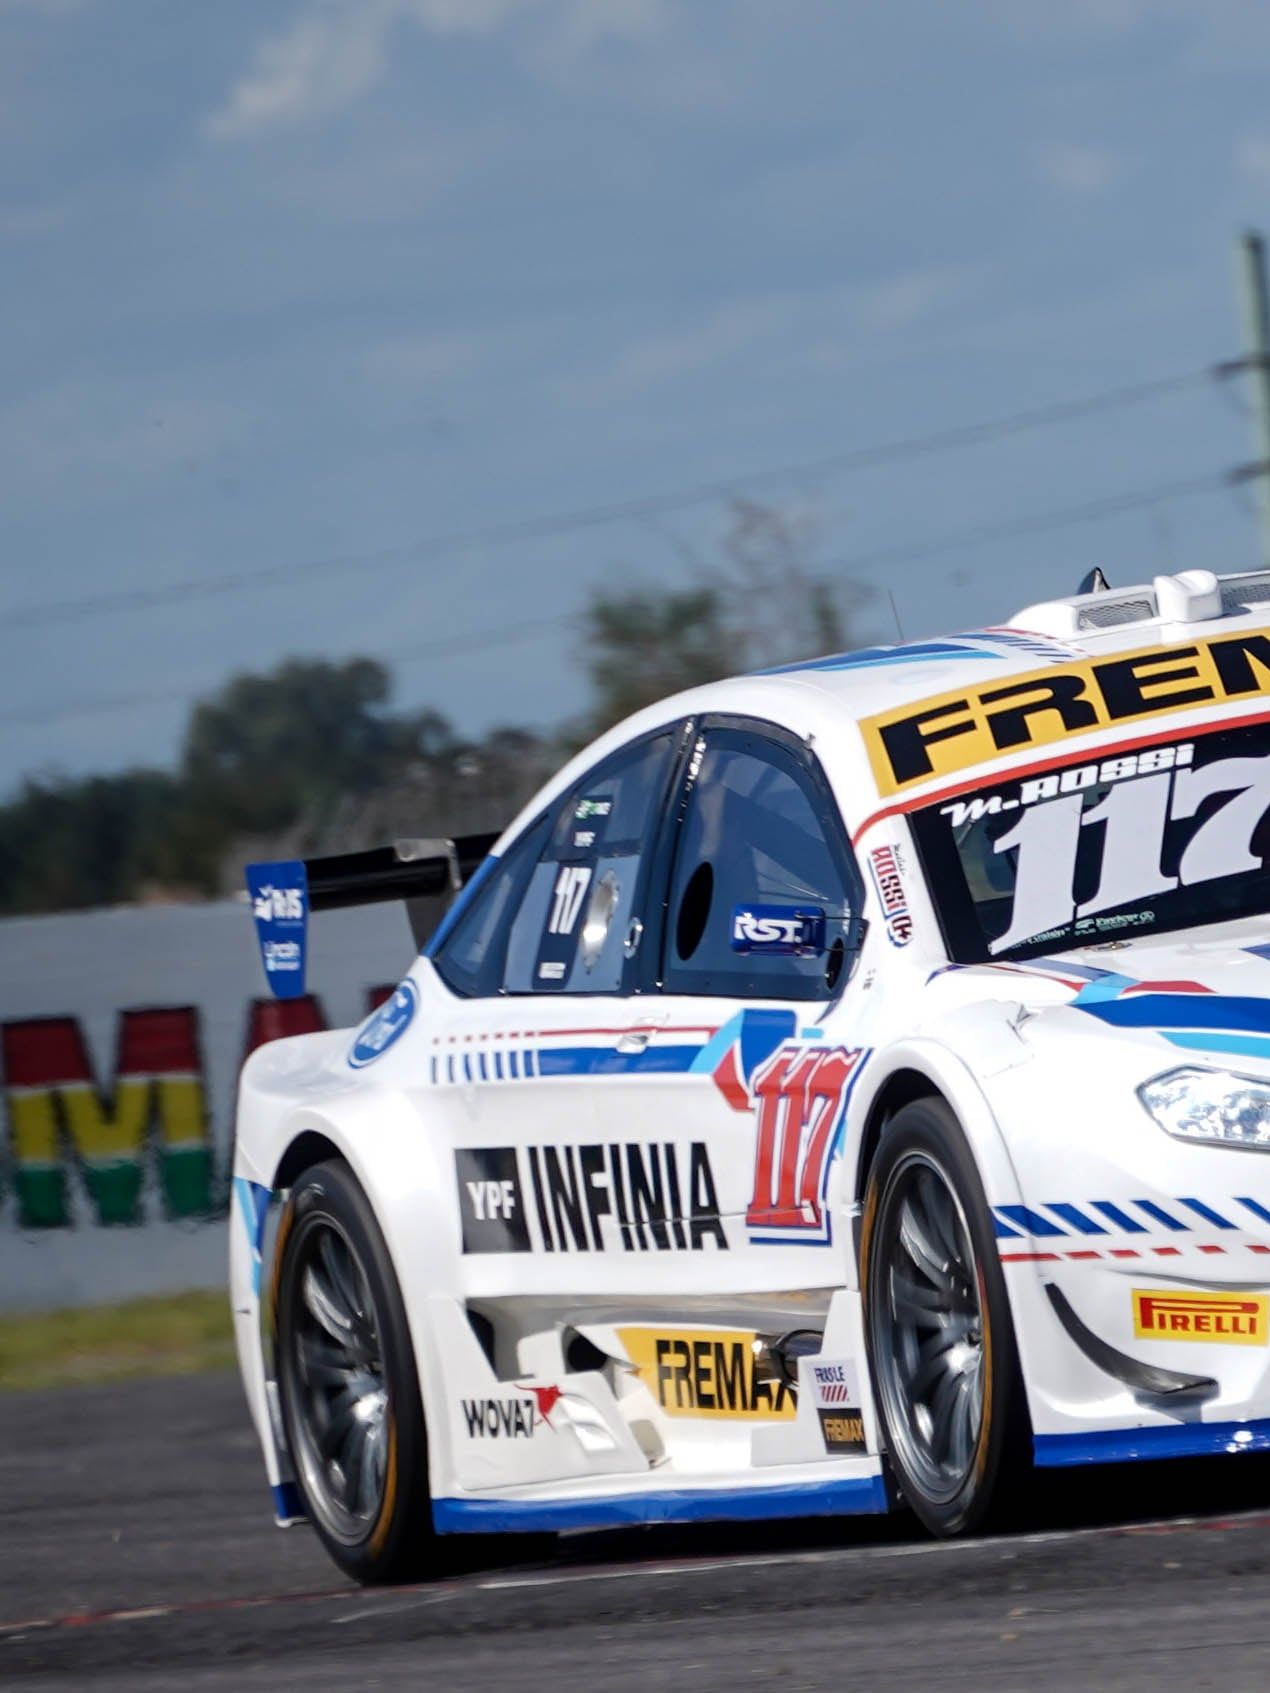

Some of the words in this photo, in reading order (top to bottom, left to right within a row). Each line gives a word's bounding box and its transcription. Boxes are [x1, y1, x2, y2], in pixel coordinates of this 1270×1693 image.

[745, 1046, 864, 1234] 117
[466, 1180, 516, 1221] YPF
[528, 1142, 729, 1253] INFINIA
[1139, 1297, 1260, 1335] PIRELLI
